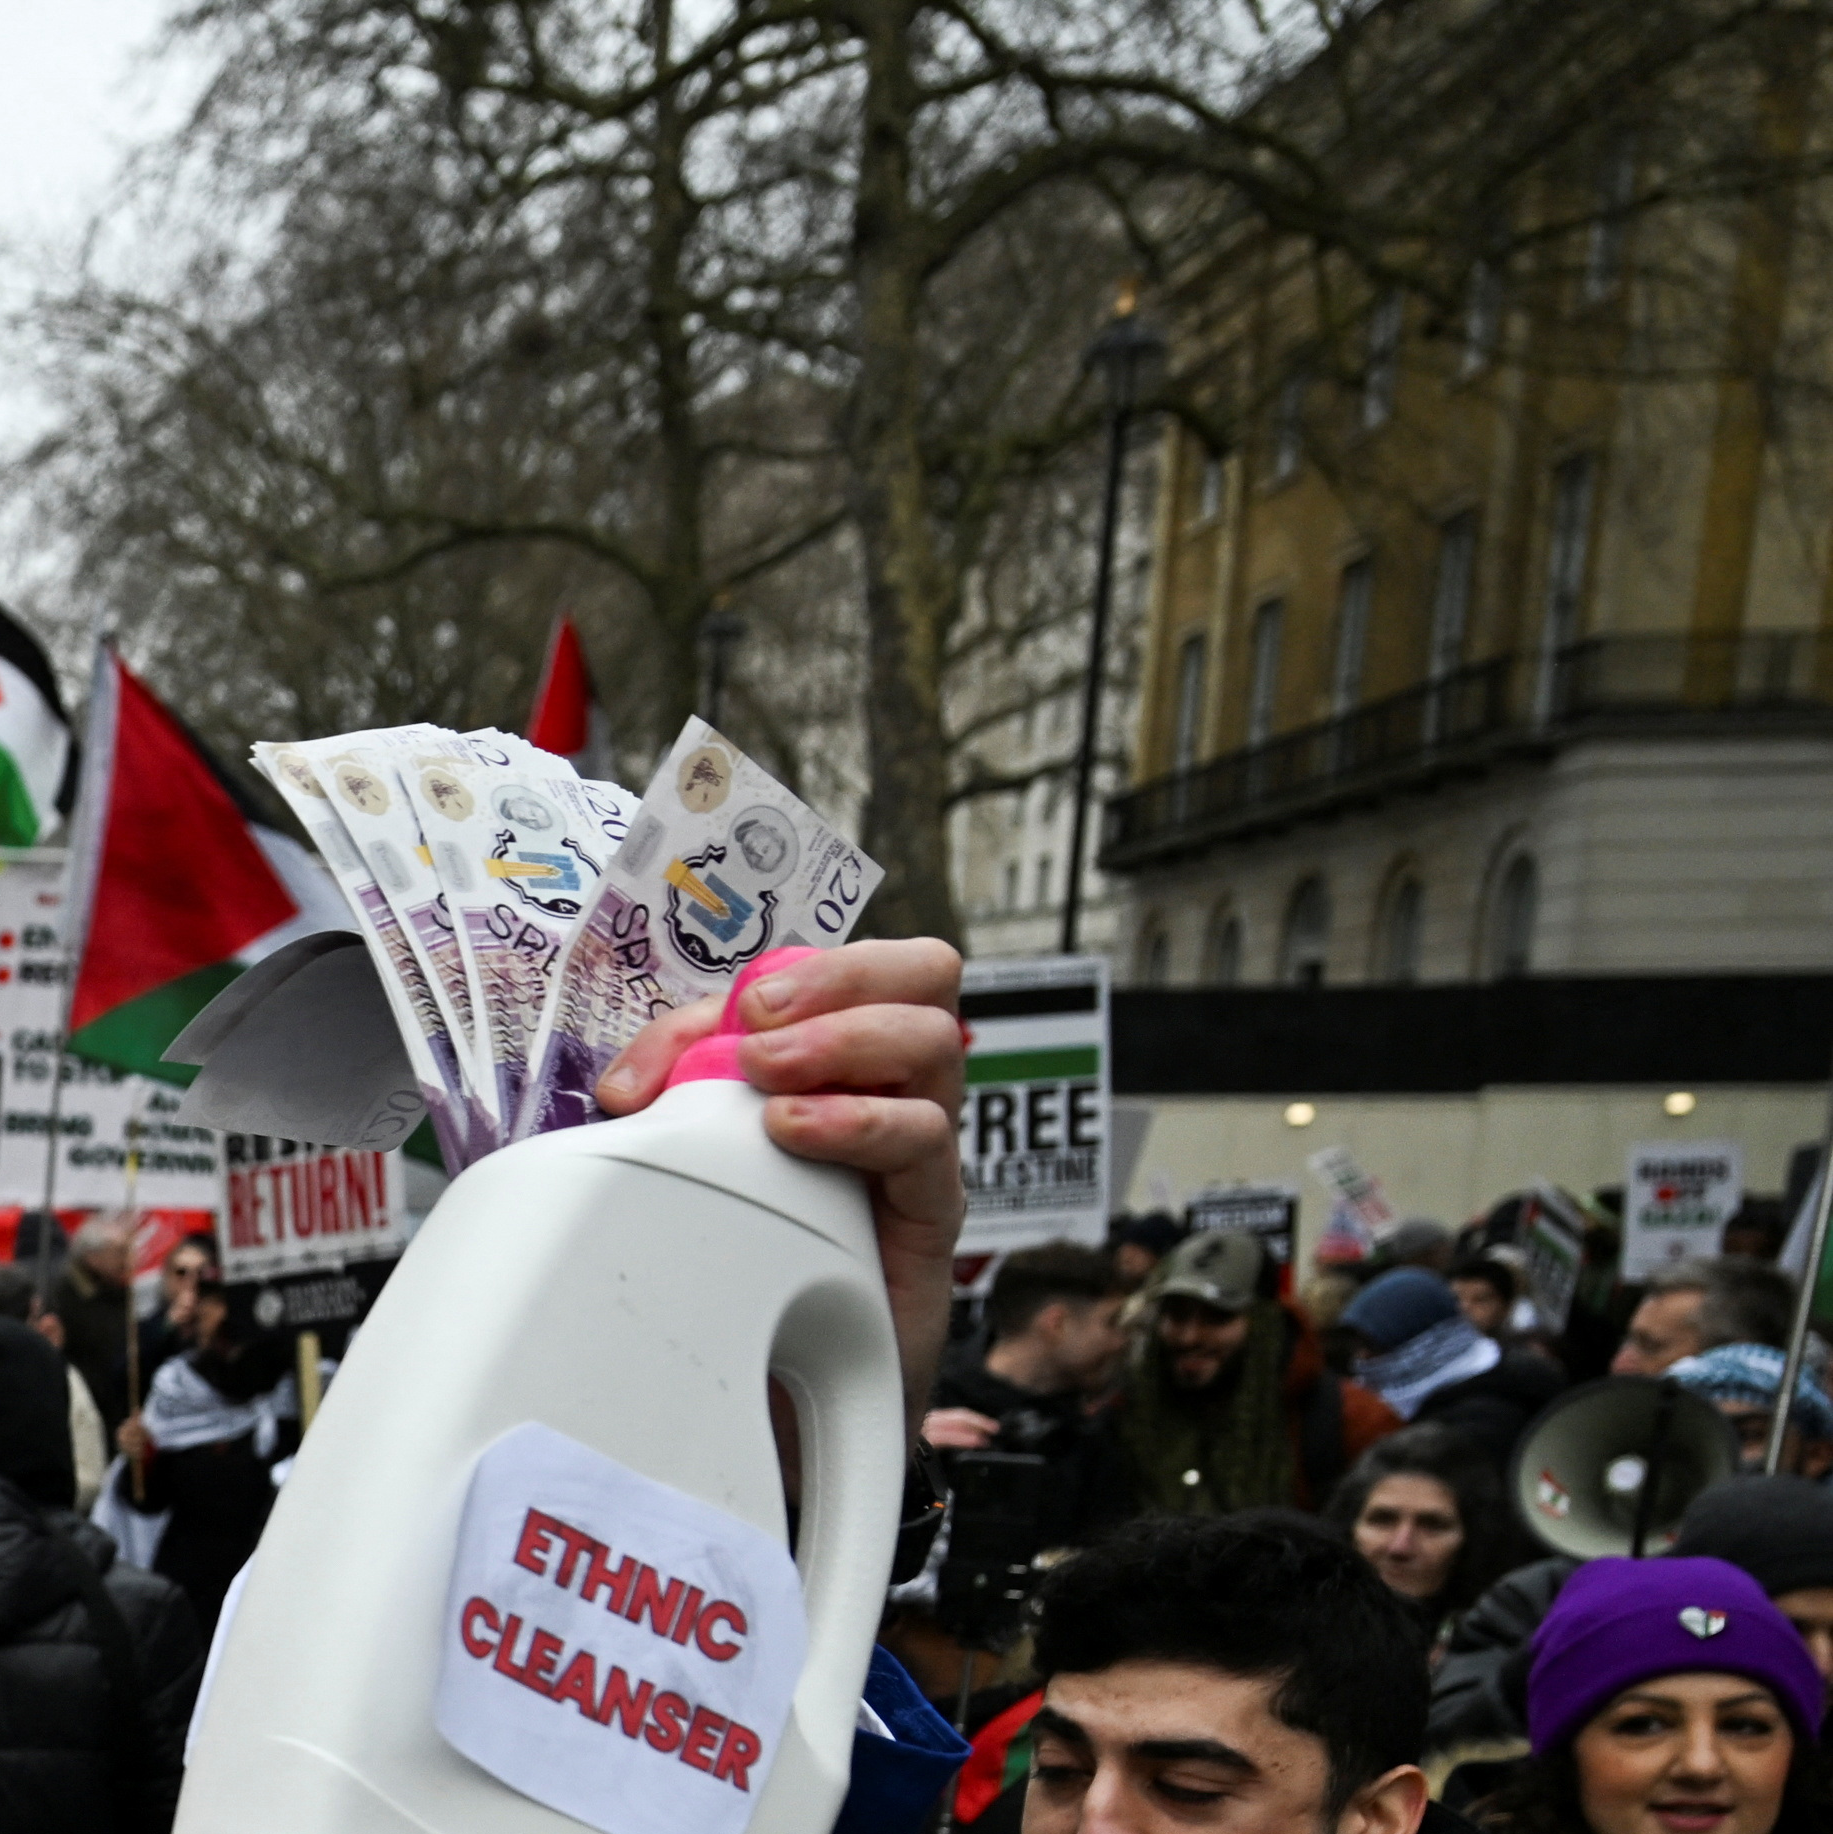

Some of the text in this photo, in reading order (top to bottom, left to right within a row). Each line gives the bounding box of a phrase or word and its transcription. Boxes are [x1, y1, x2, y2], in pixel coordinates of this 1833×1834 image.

[813, 850, 863, 934] £20
[959, 1086, 1100, 1156] REE
[227, 1150, 389, 1251] RETURN!
[512, 1506, 748, 1662] ETHNIC
[460, 1596, 762, 1793] CLEANSER
